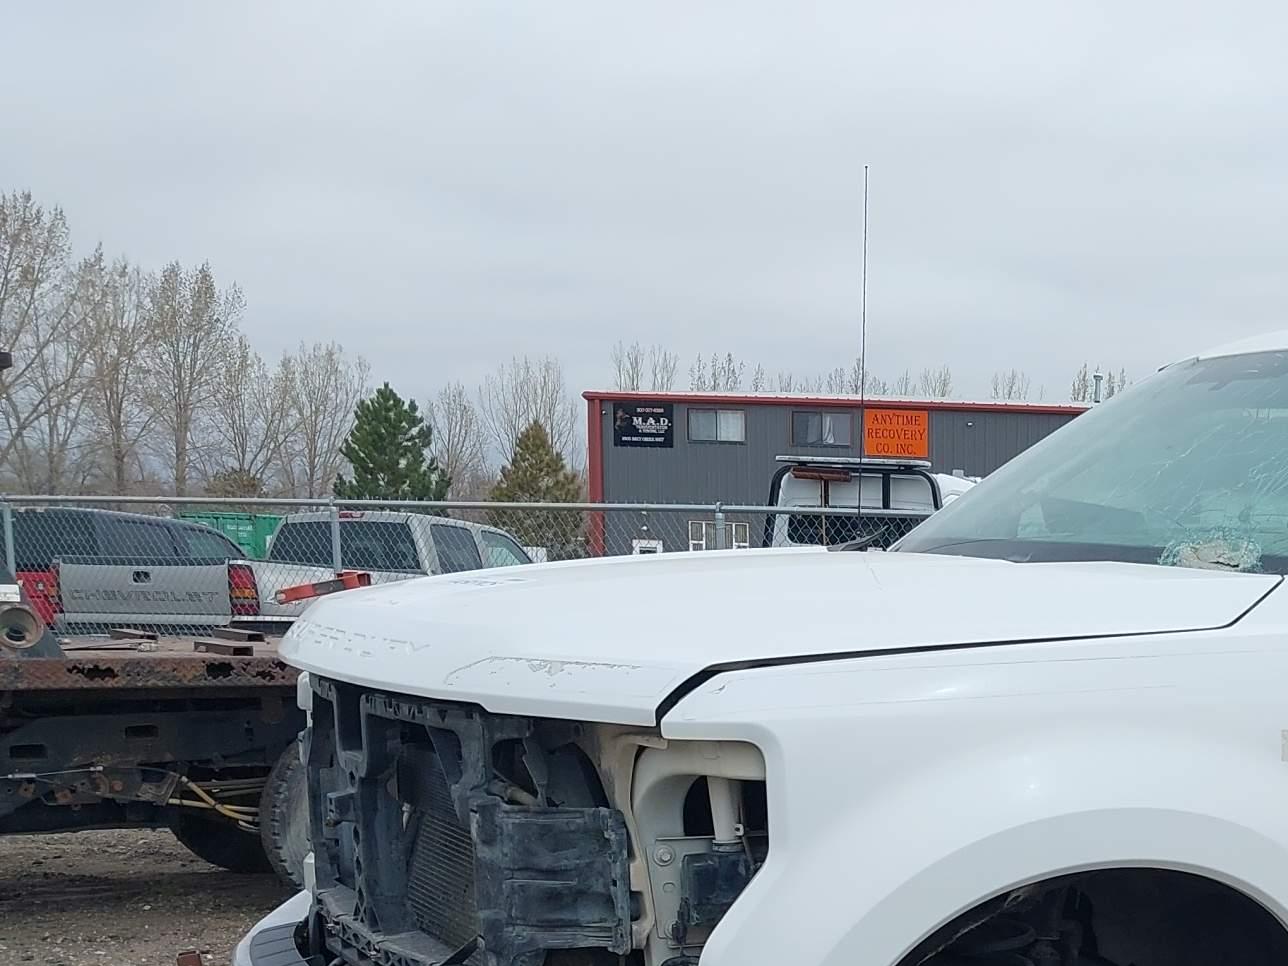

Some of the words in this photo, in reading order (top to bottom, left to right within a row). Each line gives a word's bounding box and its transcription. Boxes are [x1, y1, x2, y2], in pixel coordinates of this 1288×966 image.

[632, 416, 672, 426] M.A.D.
[872, 413, 921, 426] ANYTIME
[867, 428, 926, 441] RECOVERY
[876, 443, 893, 454] CO.
[896, 443, 917, 455] INC.
[71, 588, 219, 602] CHEVROLET
